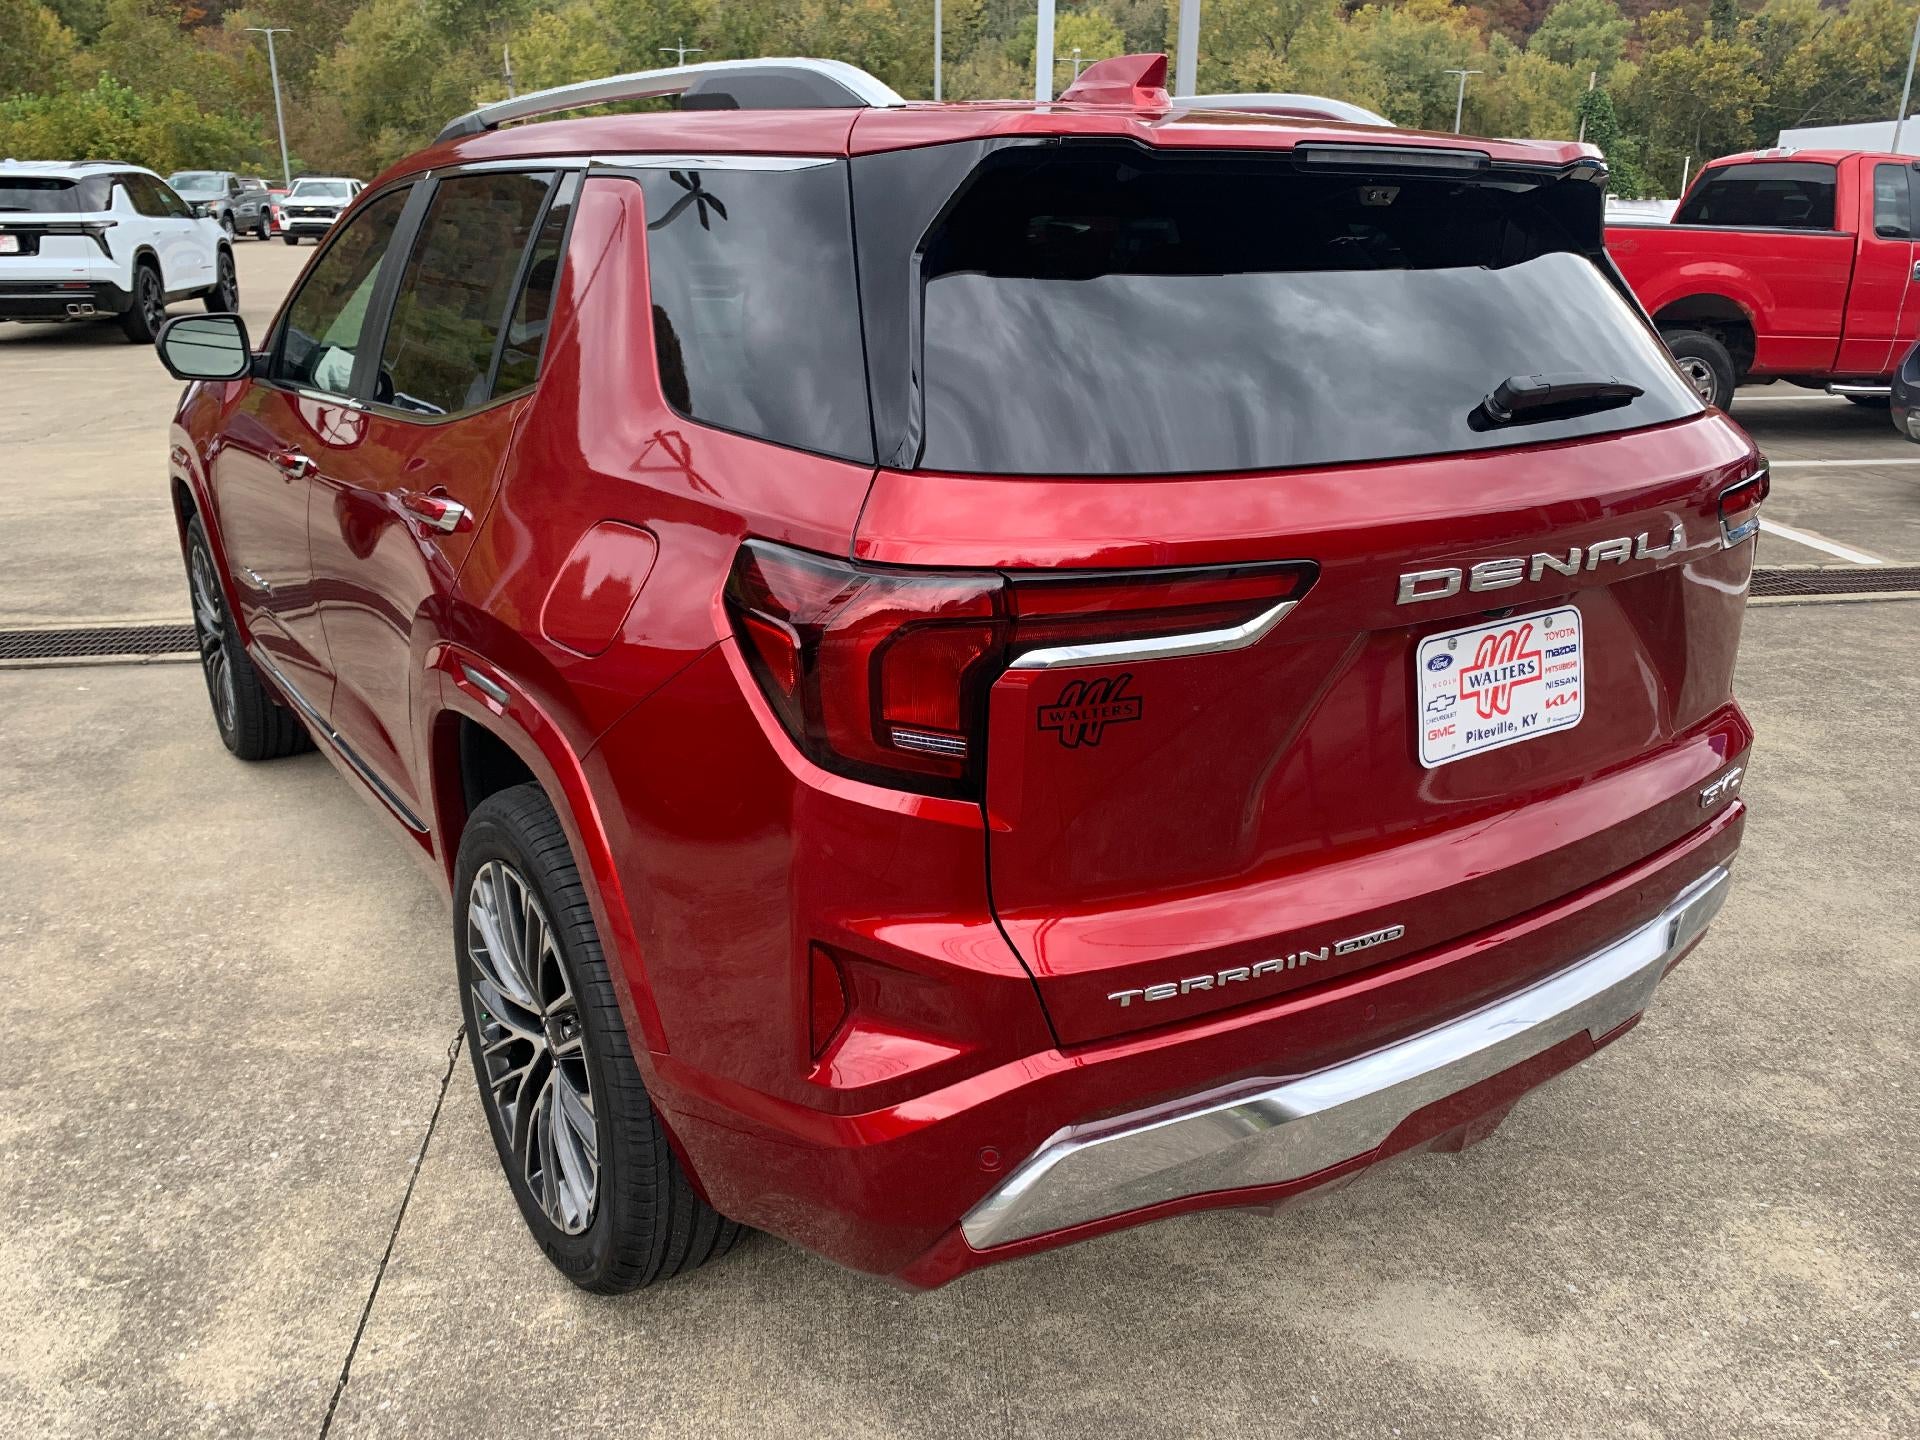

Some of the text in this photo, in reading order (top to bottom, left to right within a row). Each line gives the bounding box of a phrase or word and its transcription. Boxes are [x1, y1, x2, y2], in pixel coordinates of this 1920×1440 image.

[1396, 523, 1684, 606] DENALI
[1544, 628, 1576, 641] TOYOTA
[1468, 660, 1536, 689] WALTERS
[1545, 660, 1578, 674] MITSUBISHI
[1545, 675, 1578, 690] NISSAN
[1545, 691, 1578, 709] KIA
[1049, 703, 1134, 721] WALTERS
[1426, 711, 1457, 725] CHEVROLET
[1428, 724, 1456, 741] GMC
[1466, 721, 1518, 744] Pikeville,
[1522, 712, 1538, 728] KY
[1107, 928, 1402, 1007] TERRAIN AWD
